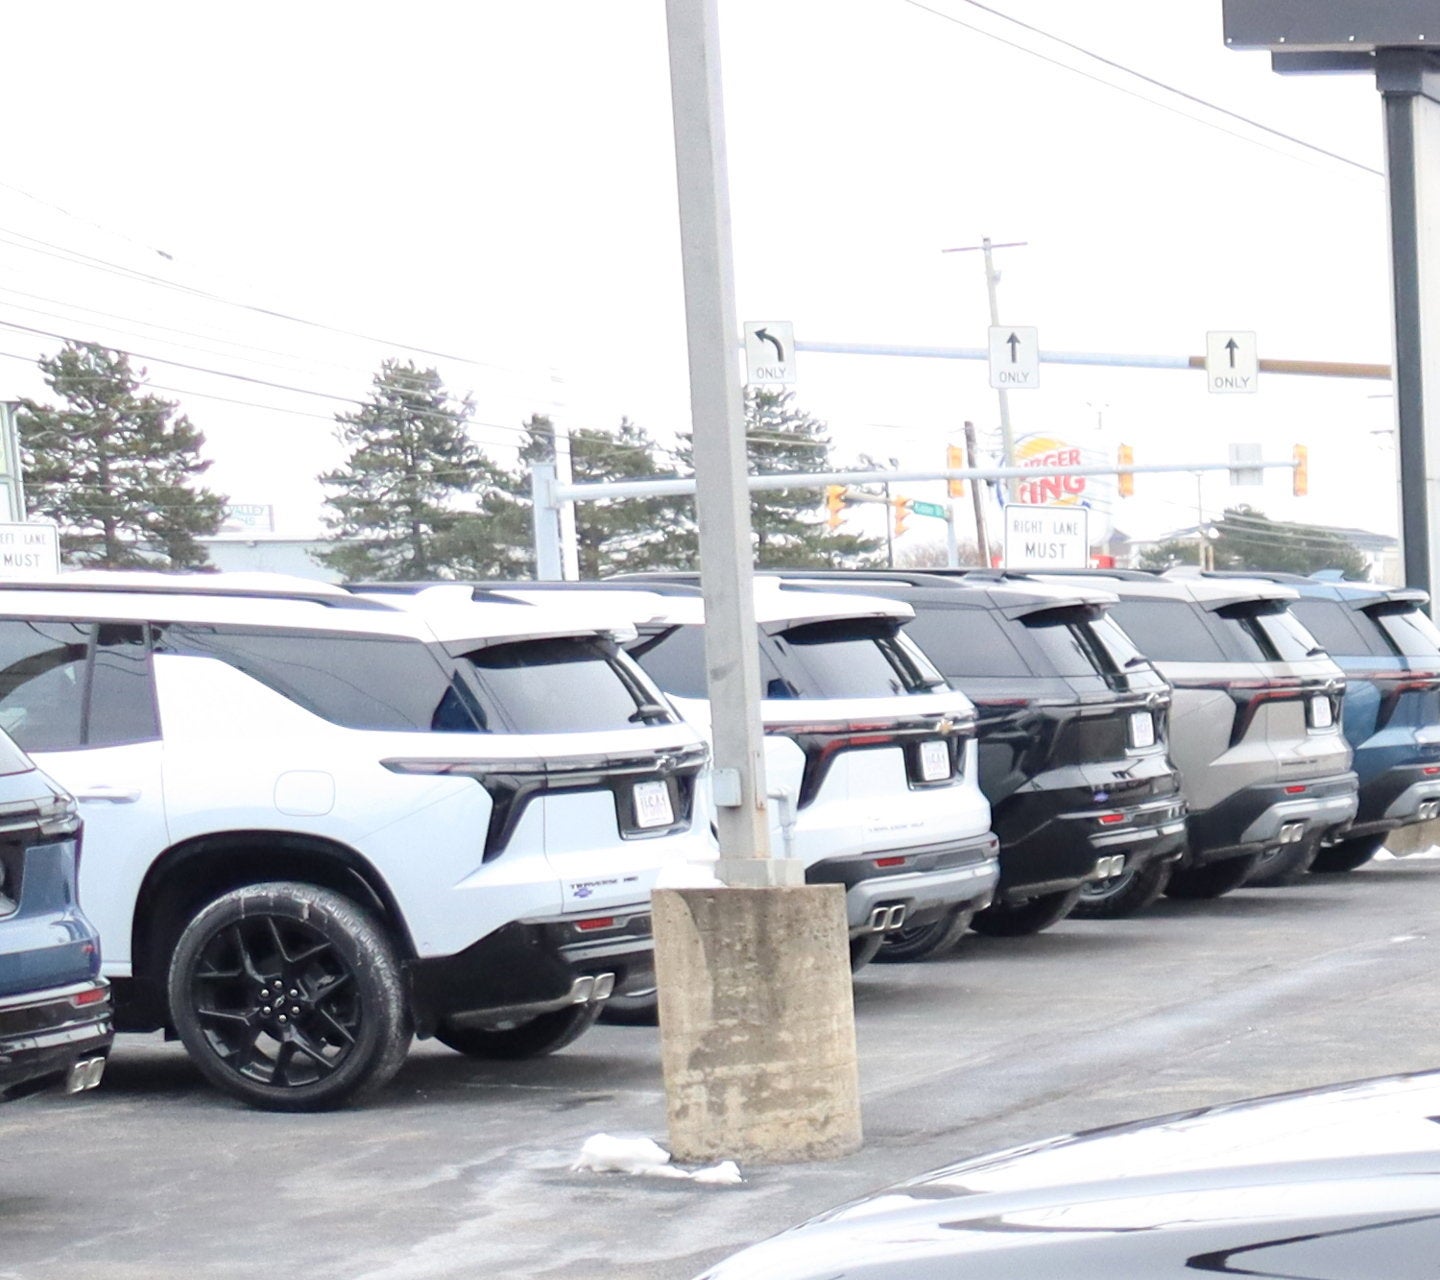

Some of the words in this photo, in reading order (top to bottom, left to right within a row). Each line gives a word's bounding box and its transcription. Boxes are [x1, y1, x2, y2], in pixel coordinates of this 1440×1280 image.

[756, 367, 786, 379] ONLY
[1000, 371, 1029, 384] ONLY
[1214, 377, 1250, 389] ONLY
[1013, 521, 1043, 534] RIGHT
[1053, 522, 1079, 536] LANE
[24, 533, 46, 545] LANE
[1025, 543, 1067, 559] MUST
[4, 556, 42, 568] MUST
